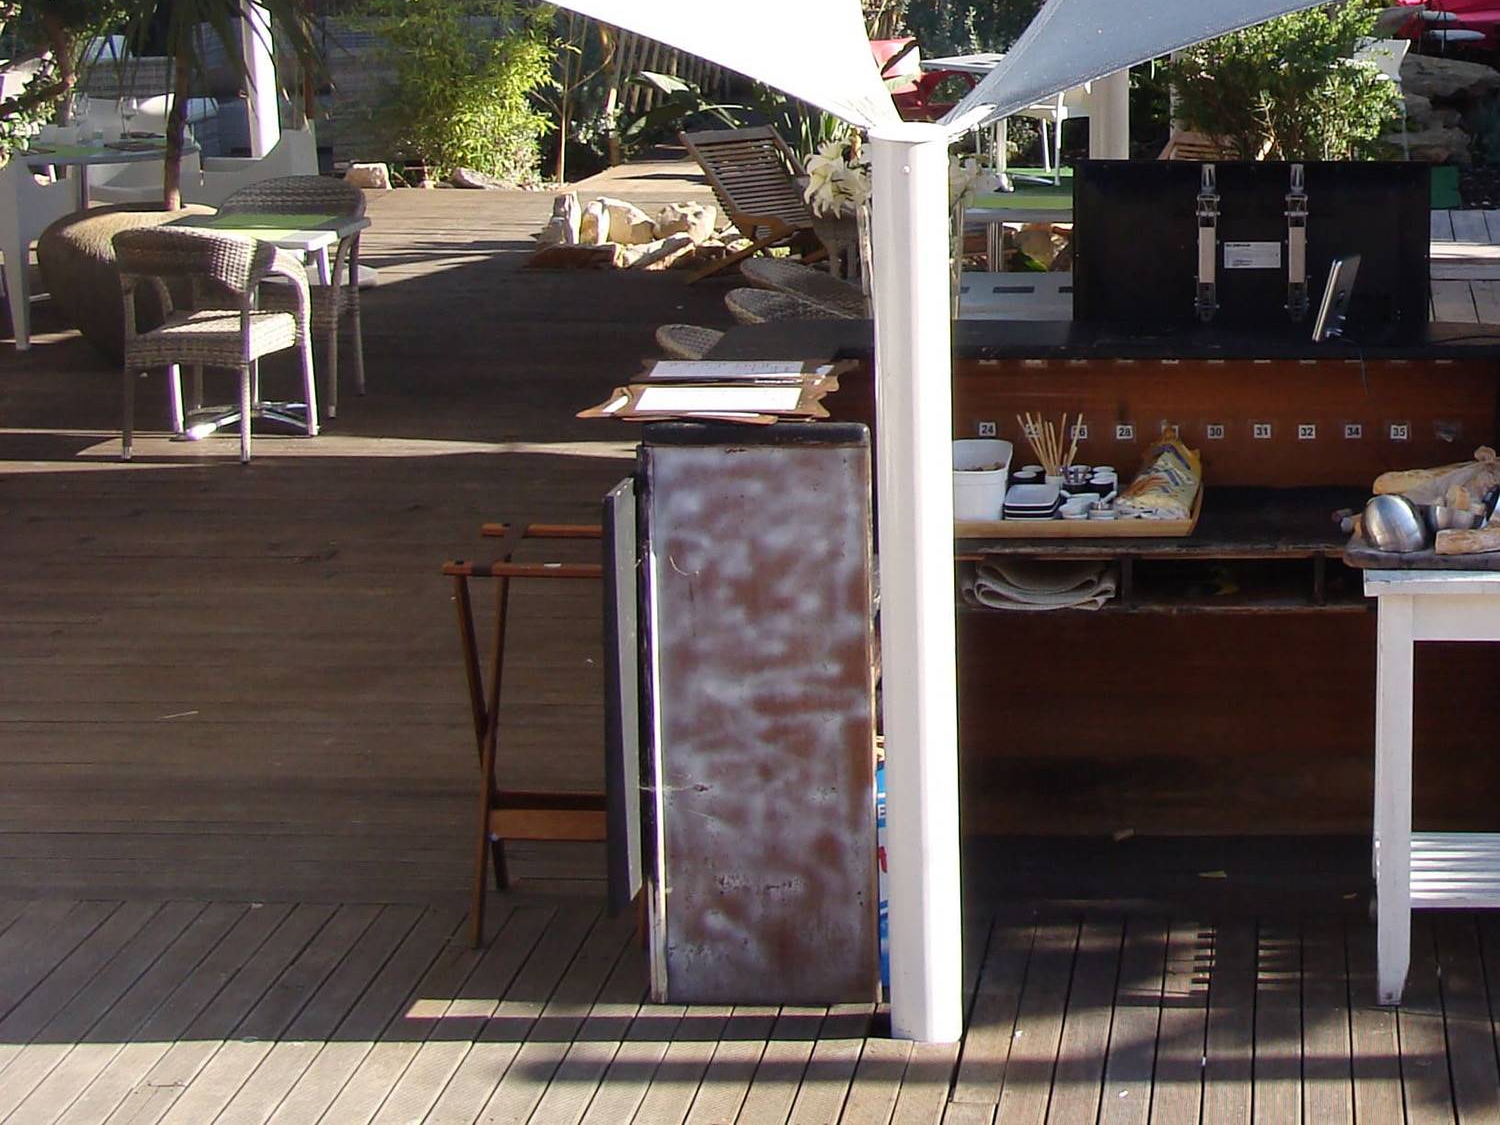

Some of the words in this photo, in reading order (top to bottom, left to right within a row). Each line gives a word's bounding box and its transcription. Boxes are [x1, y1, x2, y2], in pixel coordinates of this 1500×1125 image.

[981, 425, 994, 434] 24
[1210, 427, 1222, 436] 30
[1255, 426, 1268, 435] 31
[1301, 427, 1313, 436] 32
[1347, 426, 1360, 436] 34
[1392, 427, 1405, 436] 35
